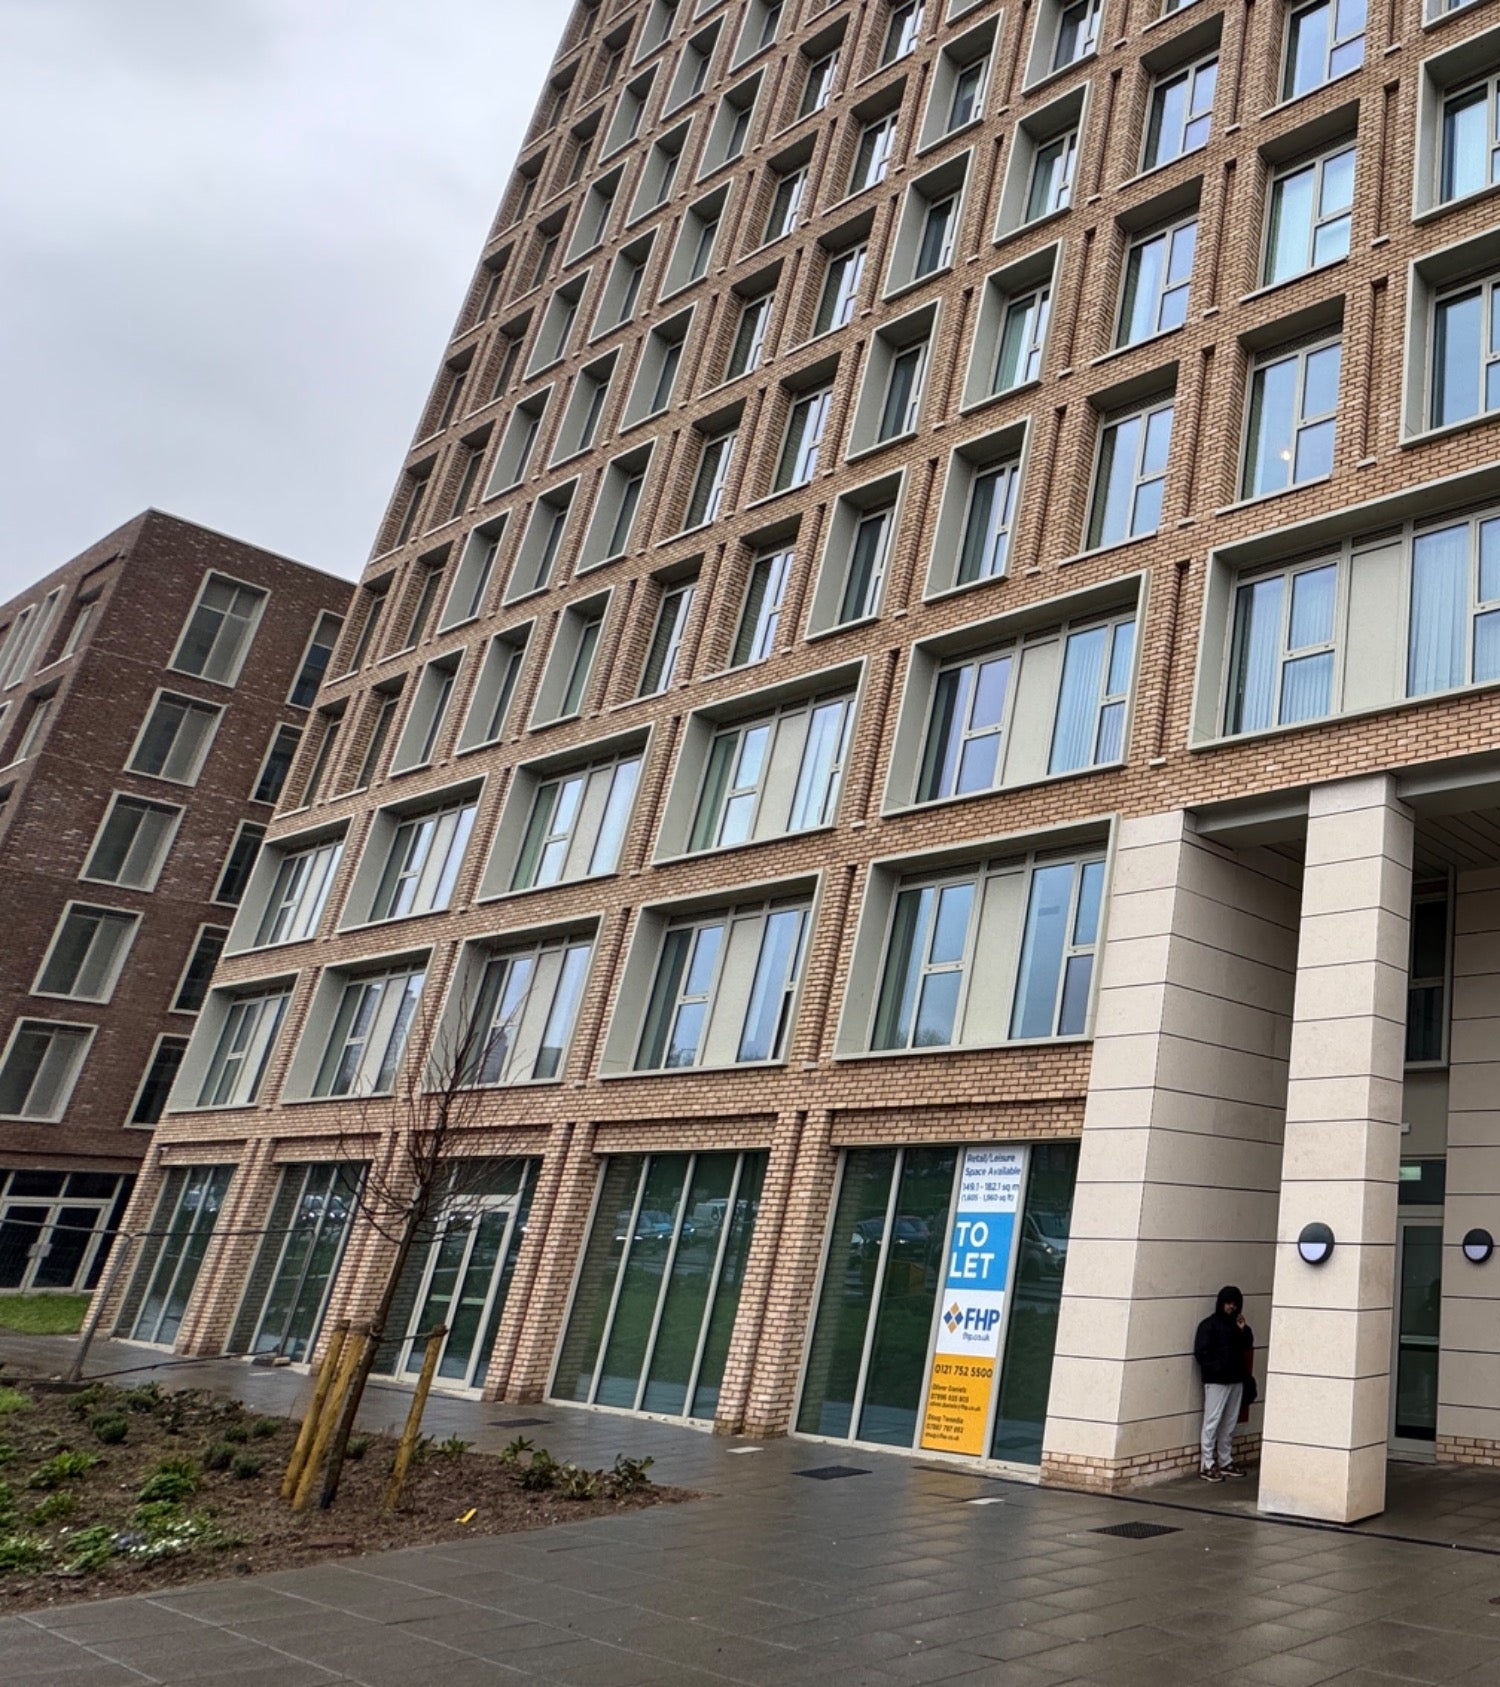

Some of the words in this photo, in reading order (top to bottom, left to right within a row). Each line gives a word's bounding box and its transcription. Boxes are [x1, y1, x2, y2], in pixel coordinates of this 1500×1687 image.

[964, 1167, 987, 1177] Space
[988, 1166, 1021, 1175] Available
[1002, 1183, 1011, 1192] sq
[956, 1221, 989, 1248] TO
[949, 1252, 995, 1279] LET
[964, 1308, 1000, 1331] FHP
[935, 1363, 952, 1374] 0121
[953, 1365, 969, 1376] 752
[970, 1366, 993, 1378] 5500
